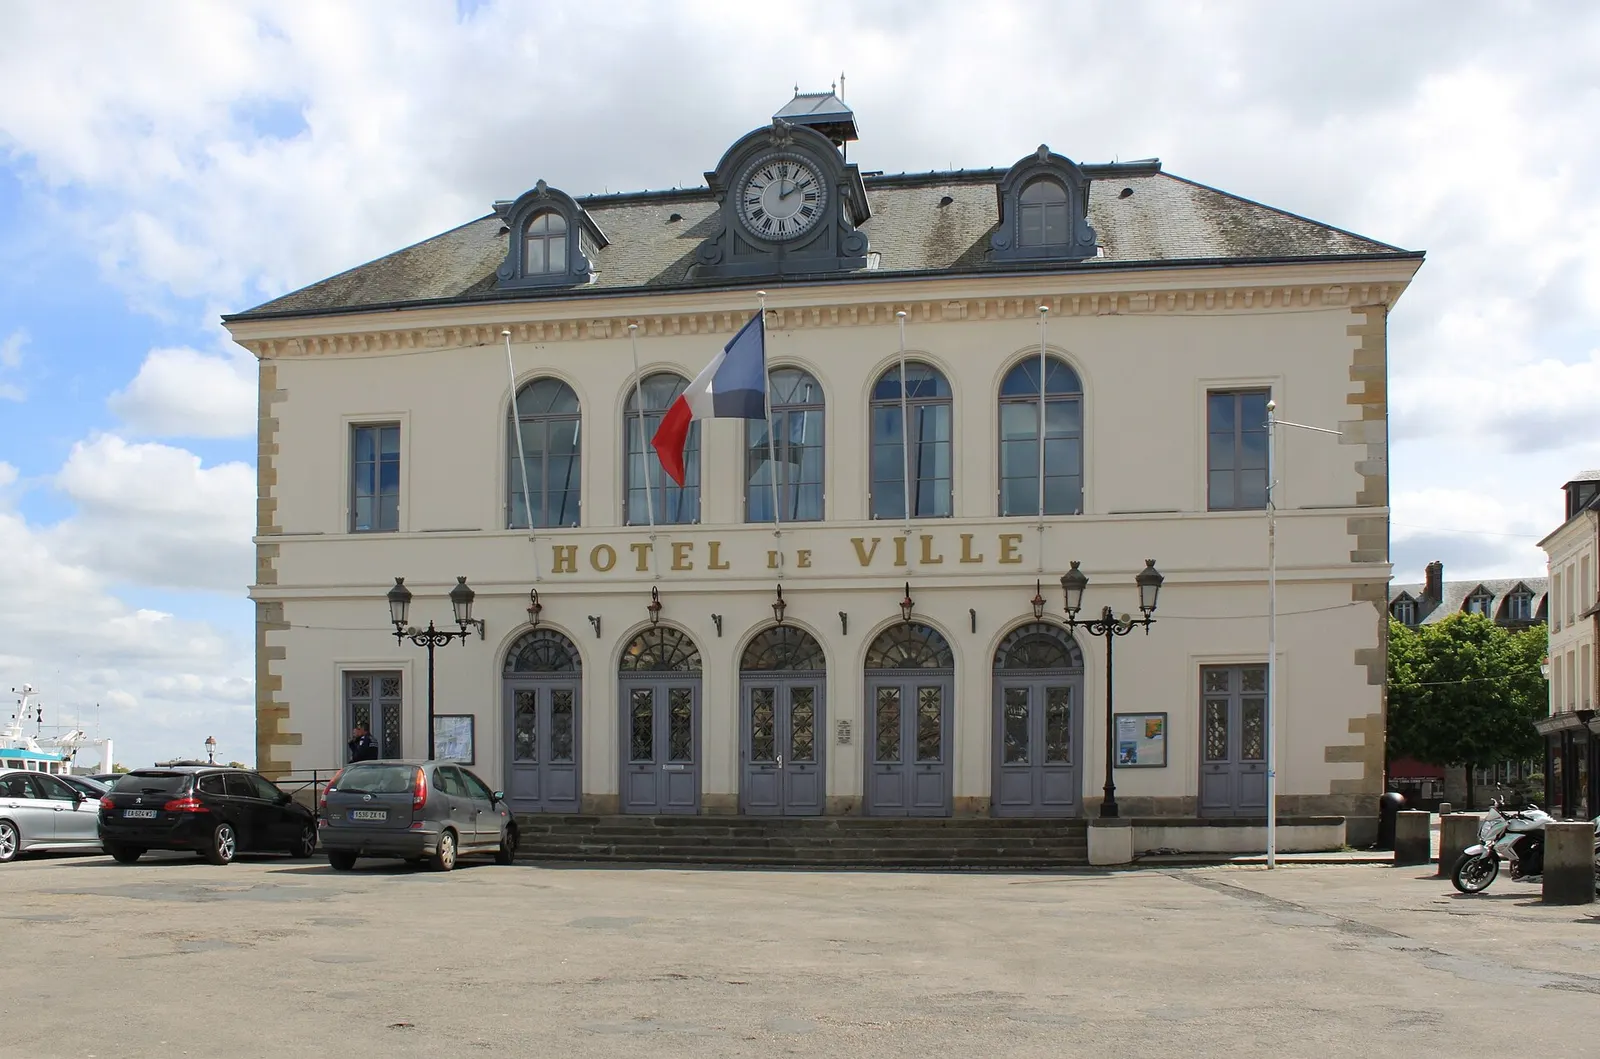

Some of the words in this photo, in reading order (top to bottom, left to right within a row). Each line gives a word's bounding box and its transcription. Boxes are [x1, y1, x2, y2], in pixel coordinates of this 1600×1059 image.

[804, 192, 816, 201] III
[551, 541, 730, 574] HOTEL
[766, 549, 812, 568] DE
[850, 534, 1023, 567] VILLE
